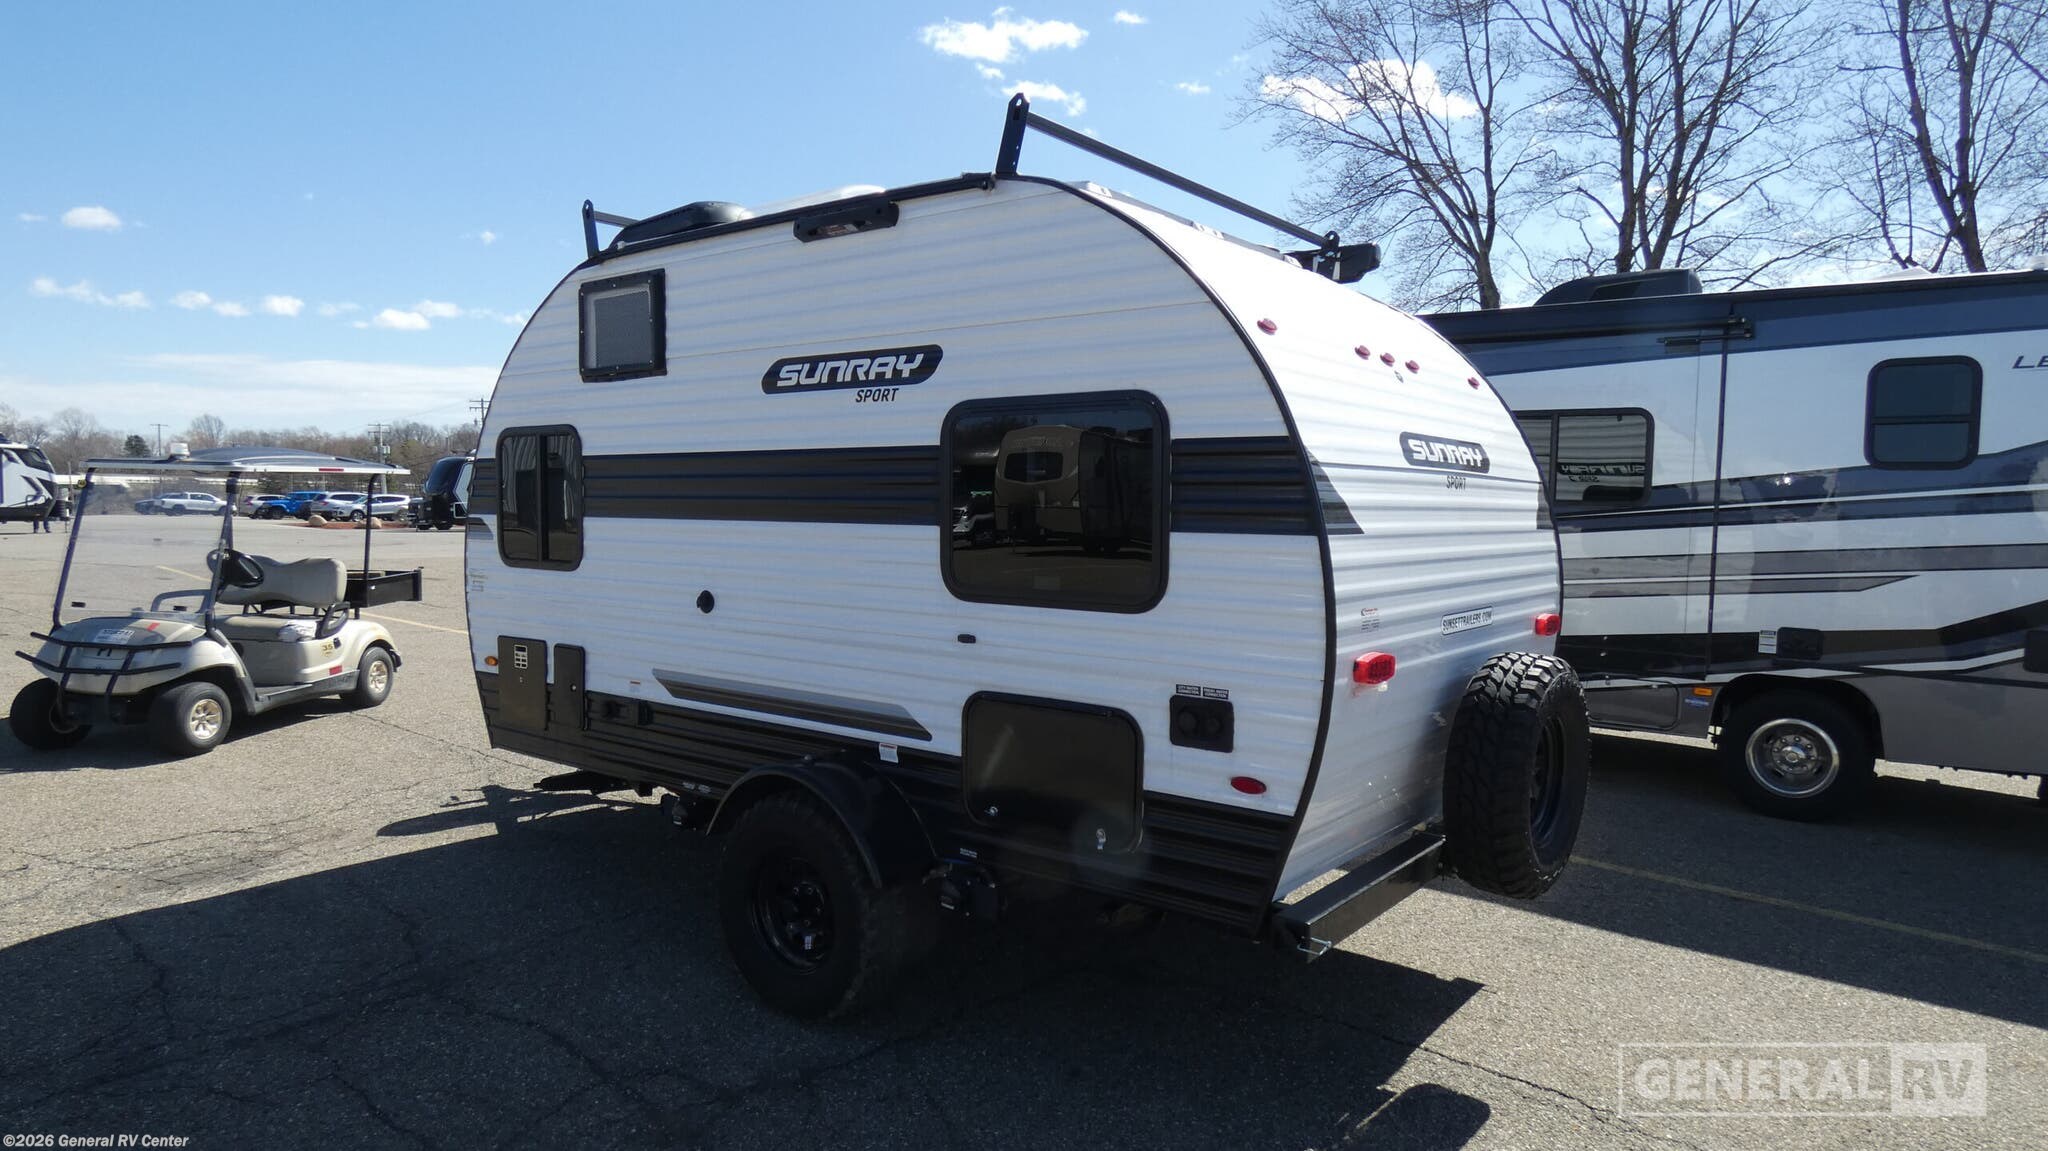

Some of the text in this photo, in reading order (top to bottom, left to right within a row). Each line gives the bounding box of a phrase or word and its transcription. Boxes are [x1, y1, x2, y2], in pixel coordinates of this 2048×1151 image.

[777, 353, 924, 387] SUNRAY
[855, 388, 899, 403] SPORT
[1408, 440, 1483, 468] SUNRAY
[1446, 475, 1467, 491] SPORT
